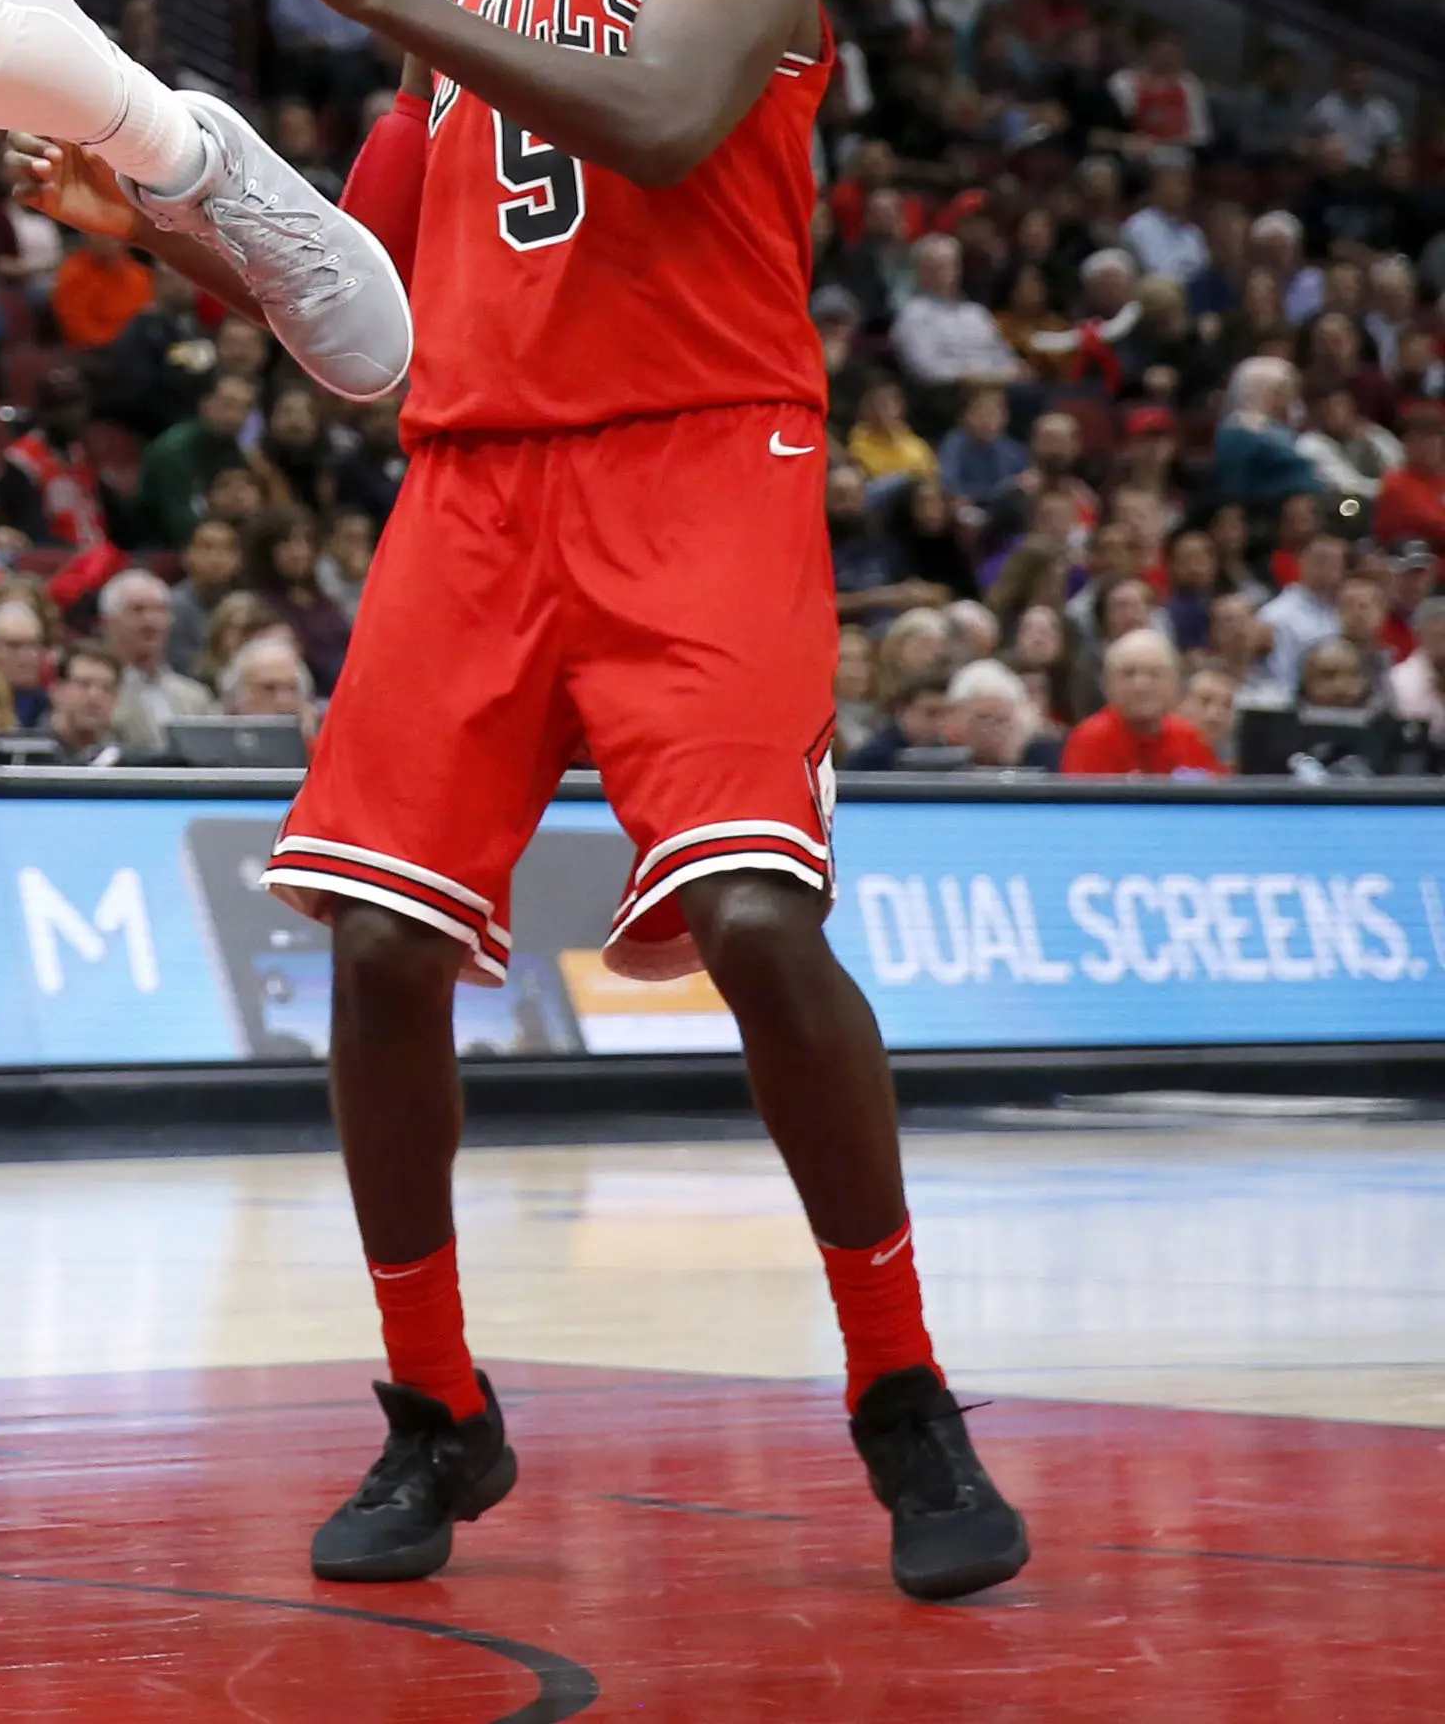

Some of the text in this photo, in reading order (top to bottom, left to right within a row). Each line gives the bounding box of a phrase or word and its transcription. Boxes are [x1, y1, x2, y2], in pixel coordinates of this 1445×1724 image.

[492, 109, 586, 252] 5
[20, 867, 159, 994] M
[856, 873, 1074, 986] DUAL
[1067, 873, 1429, 983] SCREENS.
